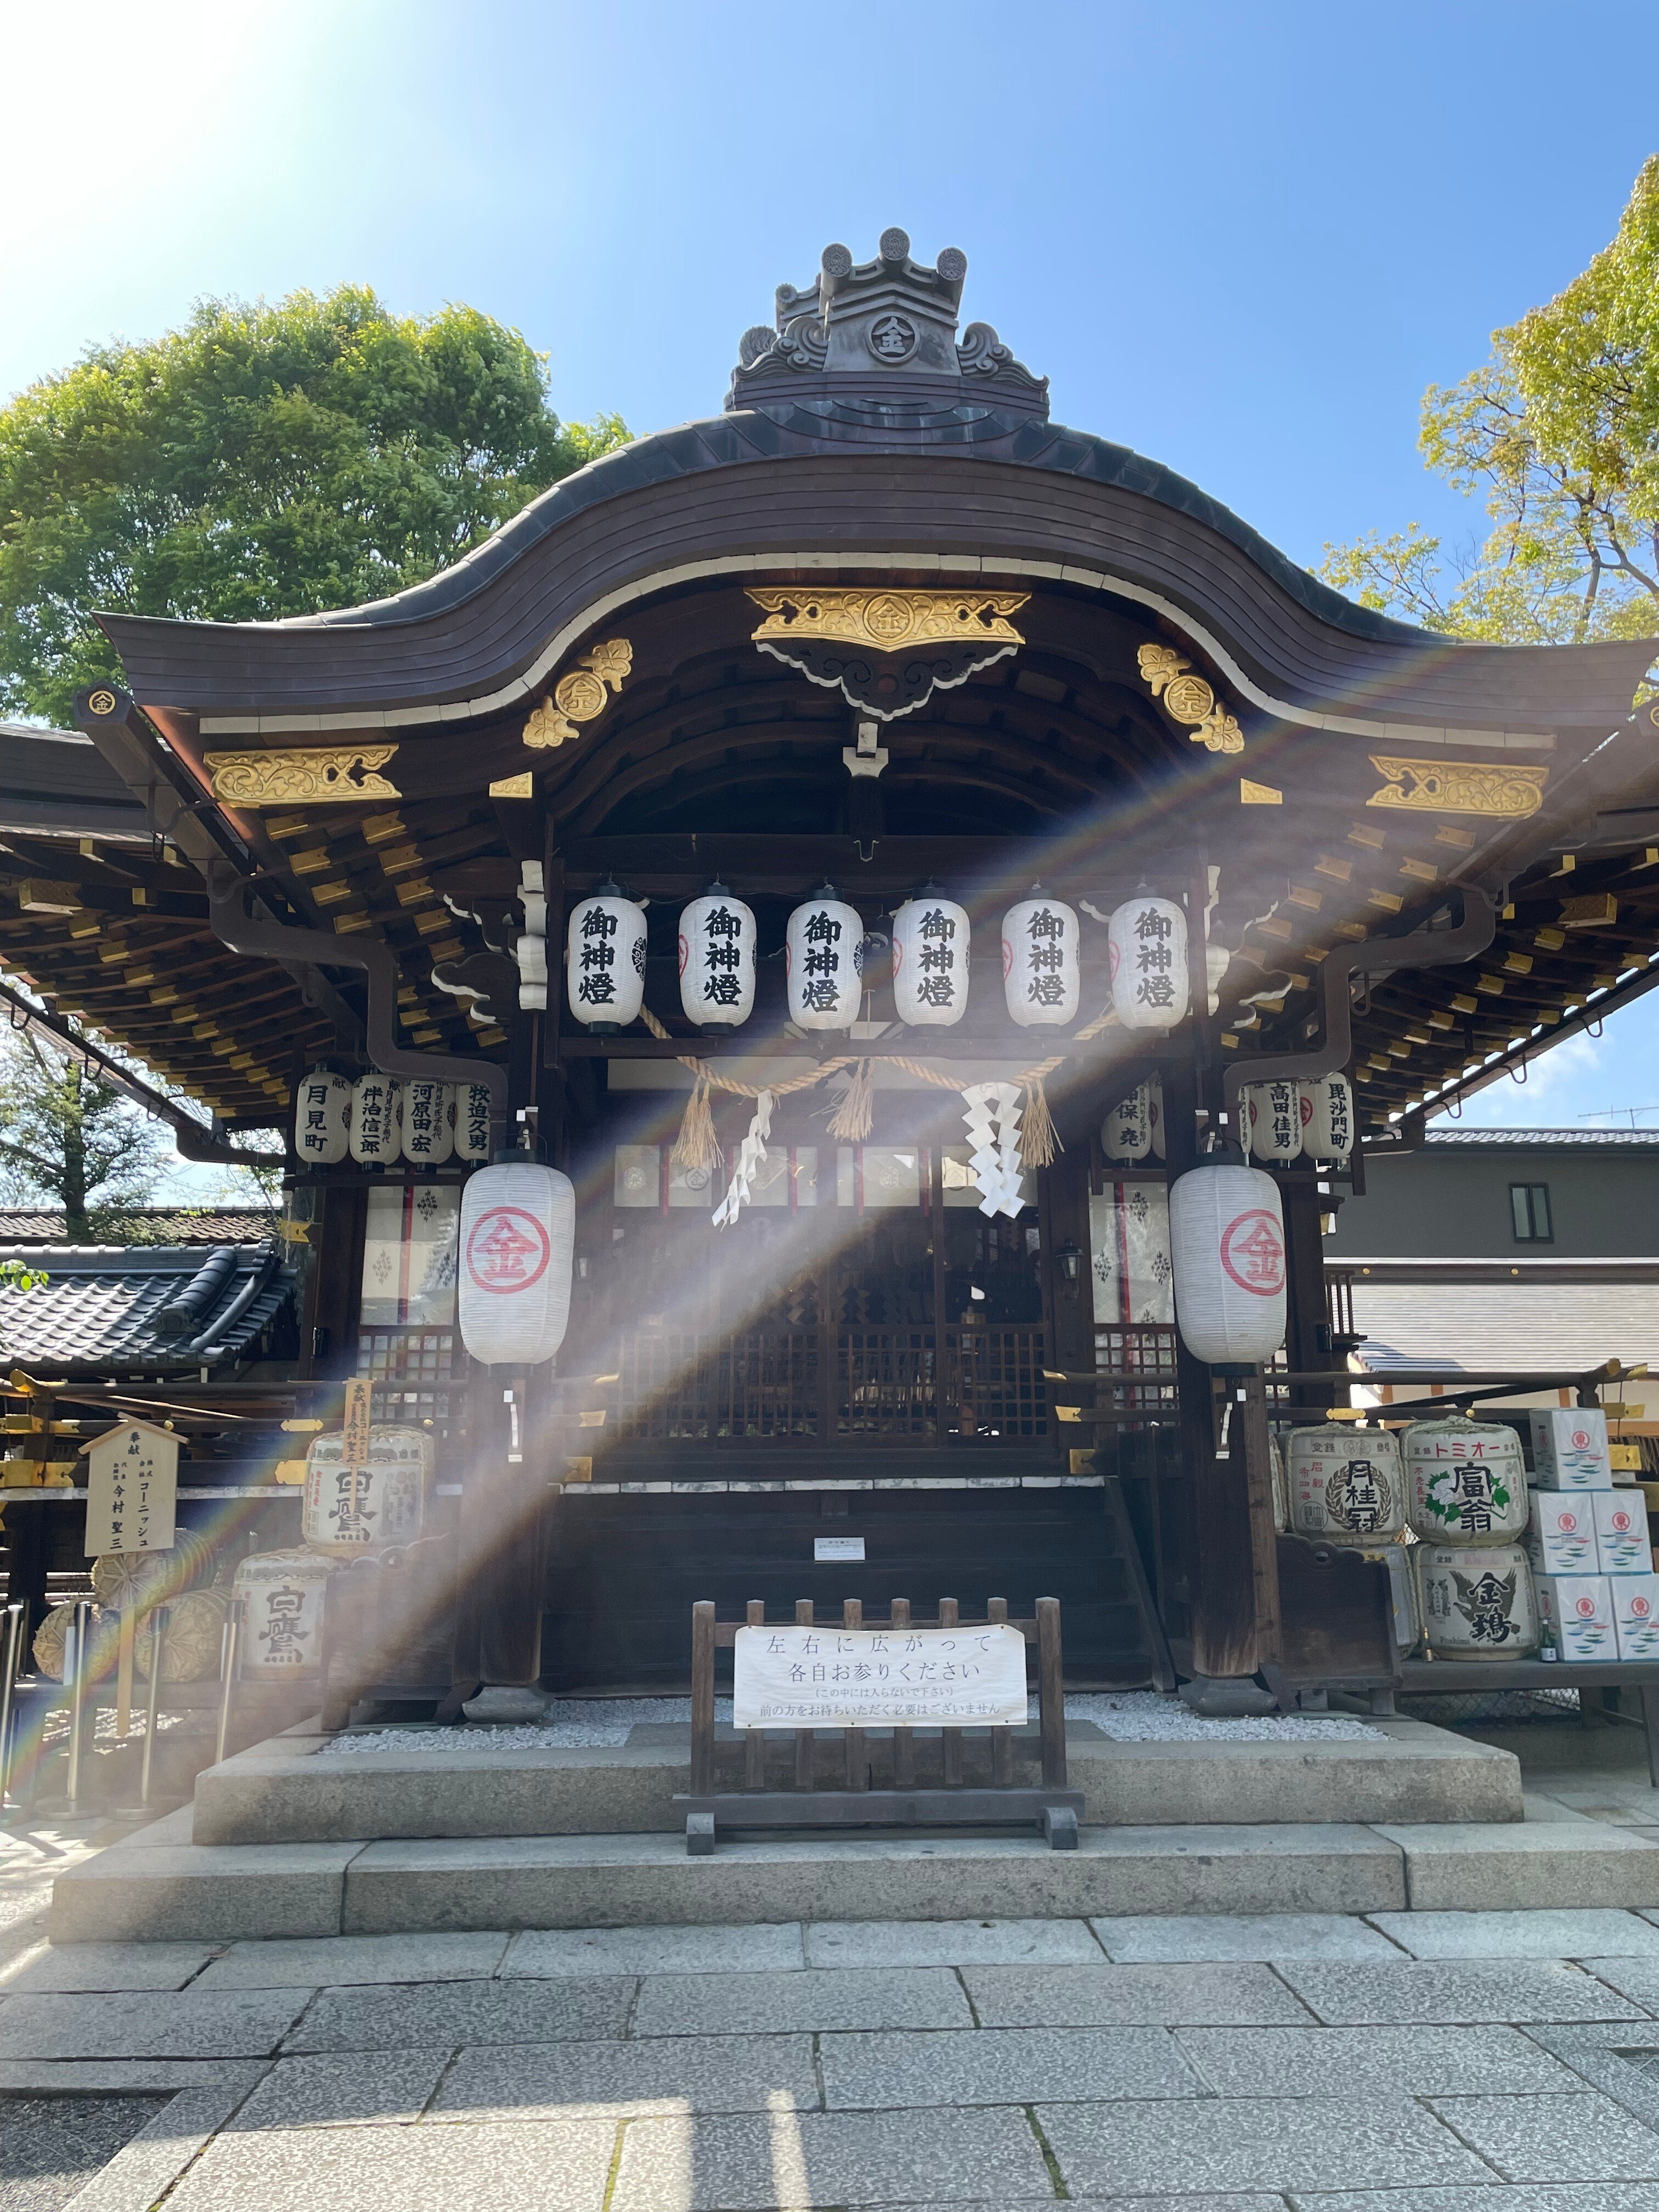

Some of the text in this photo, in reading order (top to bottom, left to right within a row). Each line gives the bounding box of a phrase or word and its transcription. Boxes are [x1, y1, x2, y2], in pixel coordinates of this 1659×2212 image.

[872, 317, 913, 354] 金
[579, 906, 618, 1005] 御神燈
[703, 906, 743, 1006] 御神燈
[802, 911, 842, 1013] 御神燈
[917, 908, 956, 1007] 御神燈
[1027, 907, 1066, 1007] 御神燈
[1133, 907, 1176, 1008] 御神燈
[305, 1085, 329, 1152] 月見町
[360, 1086, 383, 1154] 伴治信一郎
[411, 1084, 435, 1153] 河原田宏
[1270, 1082, 1291, 1148] 高田佳男
[1329, 1084, 1349, 1149] 毘沙門町
[474, 1215, 540, 1280] 金
[1232, 1217, 1283, 1282] 金
[1436, 1441, 1500, 1458] トミオー
[110, 1485, 126, 1549] 今村聖三
[138, 1482, 149, 1547] コーニッシュ
[1346, 1460, 1378, 1533] 月桂冠
[1448, 1461, 1495, 1532] 富翁
[259, 1584, 311, 1663] 白鷹
[766, 1635, 990, 1655] 左右に広がって
[788, 1662, 980, 1682] 各自お参りください
[760, 1703, 1000, 1717] 前の方をお待ちいただく必要はございません
